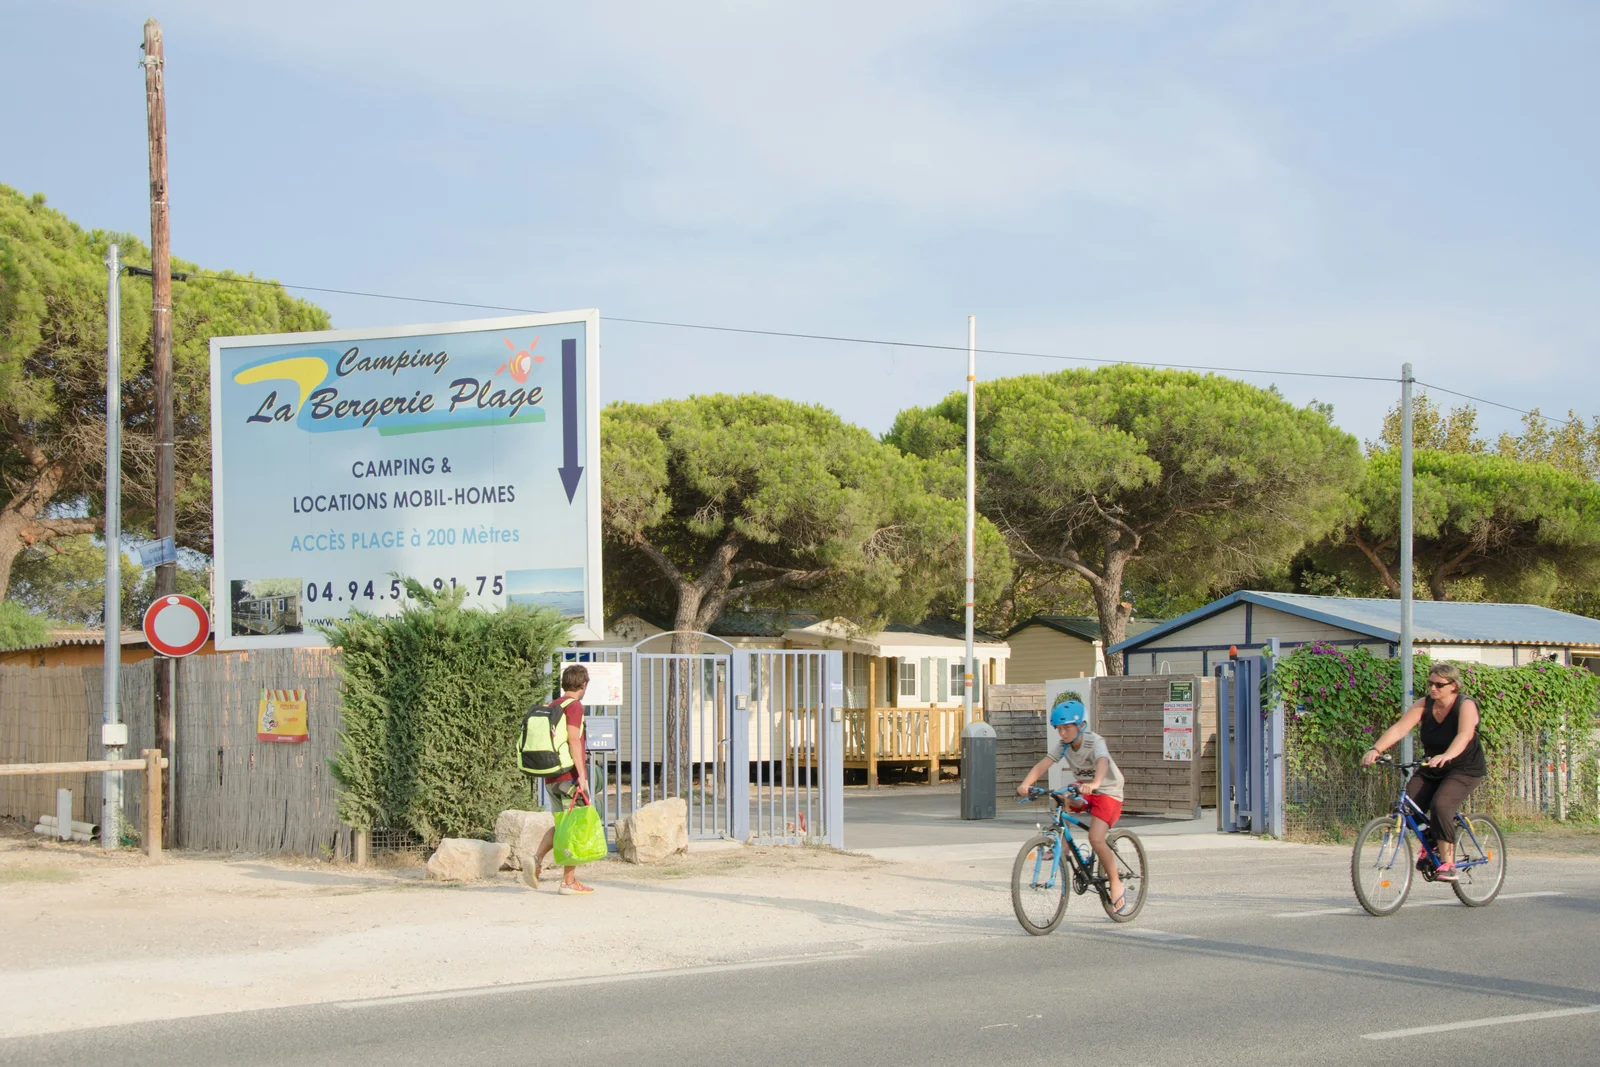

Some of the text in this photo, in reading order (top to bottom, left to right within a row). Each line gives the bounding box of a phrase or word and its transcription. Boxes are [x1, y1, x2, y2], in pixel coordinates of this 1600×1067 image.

[335, 346, 450, 376] Camping
[246, 377, 544, 427] La Bergerie Plage
[352, 457, 452, 478] CAMPING &
[293, 485, 515, 513] LOCATIONS MOBIL-HOMES
[290, 525, 520, 552] ACCÈS PLAGE à 200 Mètres
